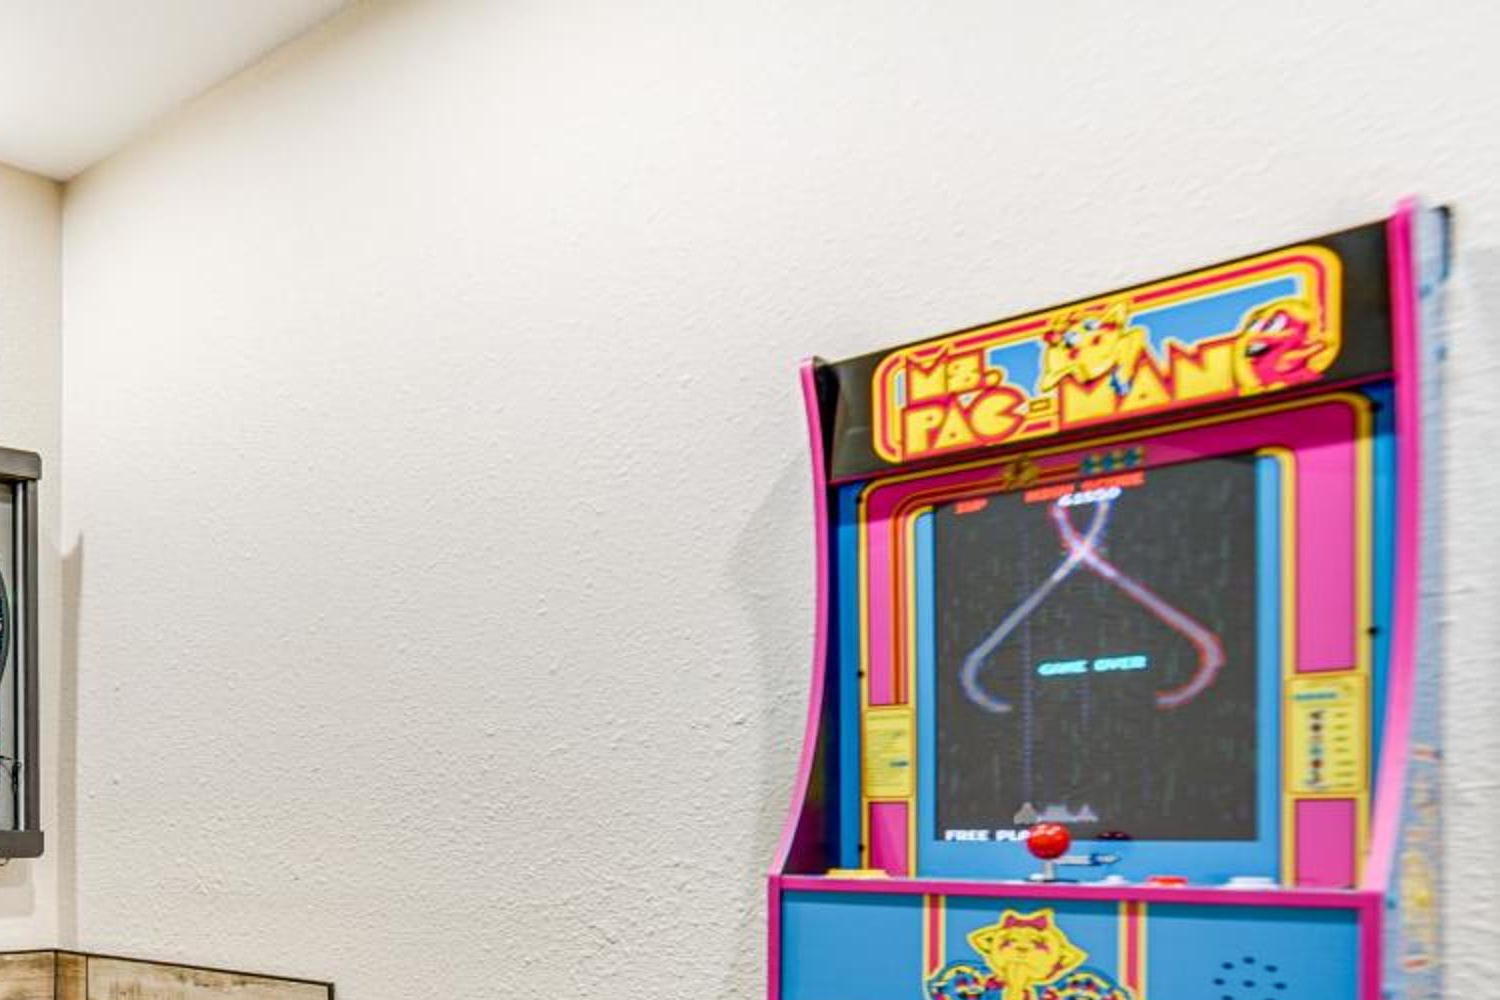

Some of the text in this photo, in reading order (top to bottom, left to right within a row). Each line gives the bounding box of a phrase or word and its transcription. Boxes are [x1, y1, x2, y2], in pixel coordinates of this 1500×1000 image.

[903, 342, 1237, 457] PAC-MAN
[944, 829, 1032, 841] FREE PLA
